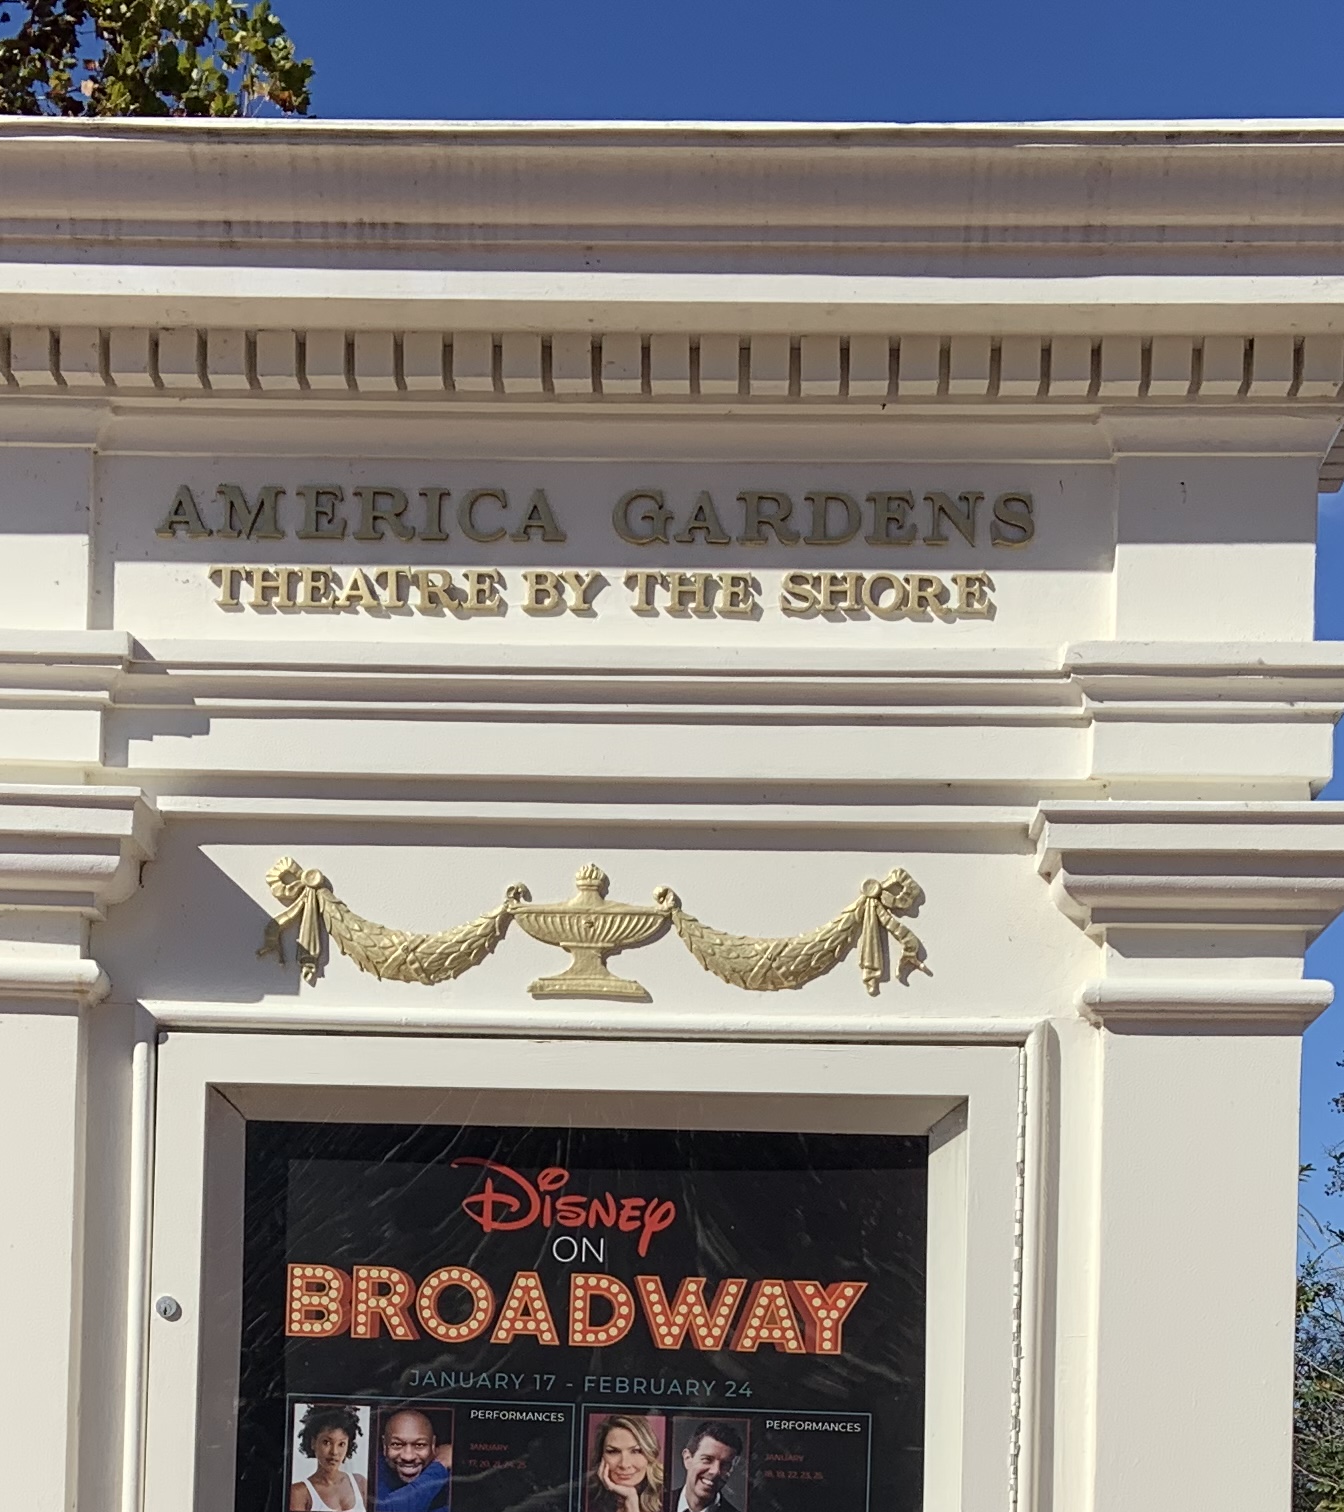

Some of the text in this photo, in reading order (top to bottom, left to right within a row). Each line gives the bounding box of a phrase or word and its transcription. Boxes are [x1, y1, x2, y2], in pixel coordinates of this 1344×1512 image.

[154, 484, 1038, 548] AMERICA GARDENS
[209, 566, 996, 620] THEATRE BY THE SHORE
[553, 1236, 604, 1264] ON
[285, 1263, 868, 1355] BROADWAY
[409, 1369, 526, 1392] JANUARY
[533, 1373, 555, 1393] 17
[584, 1375, 717, 1397] FEBRUARY
[724, 1378, 753, 1398] 24
[470, 1409, 564, 1422] PERFORMANCES
[765, 1419, 861, 1432] PERFORMANCES
